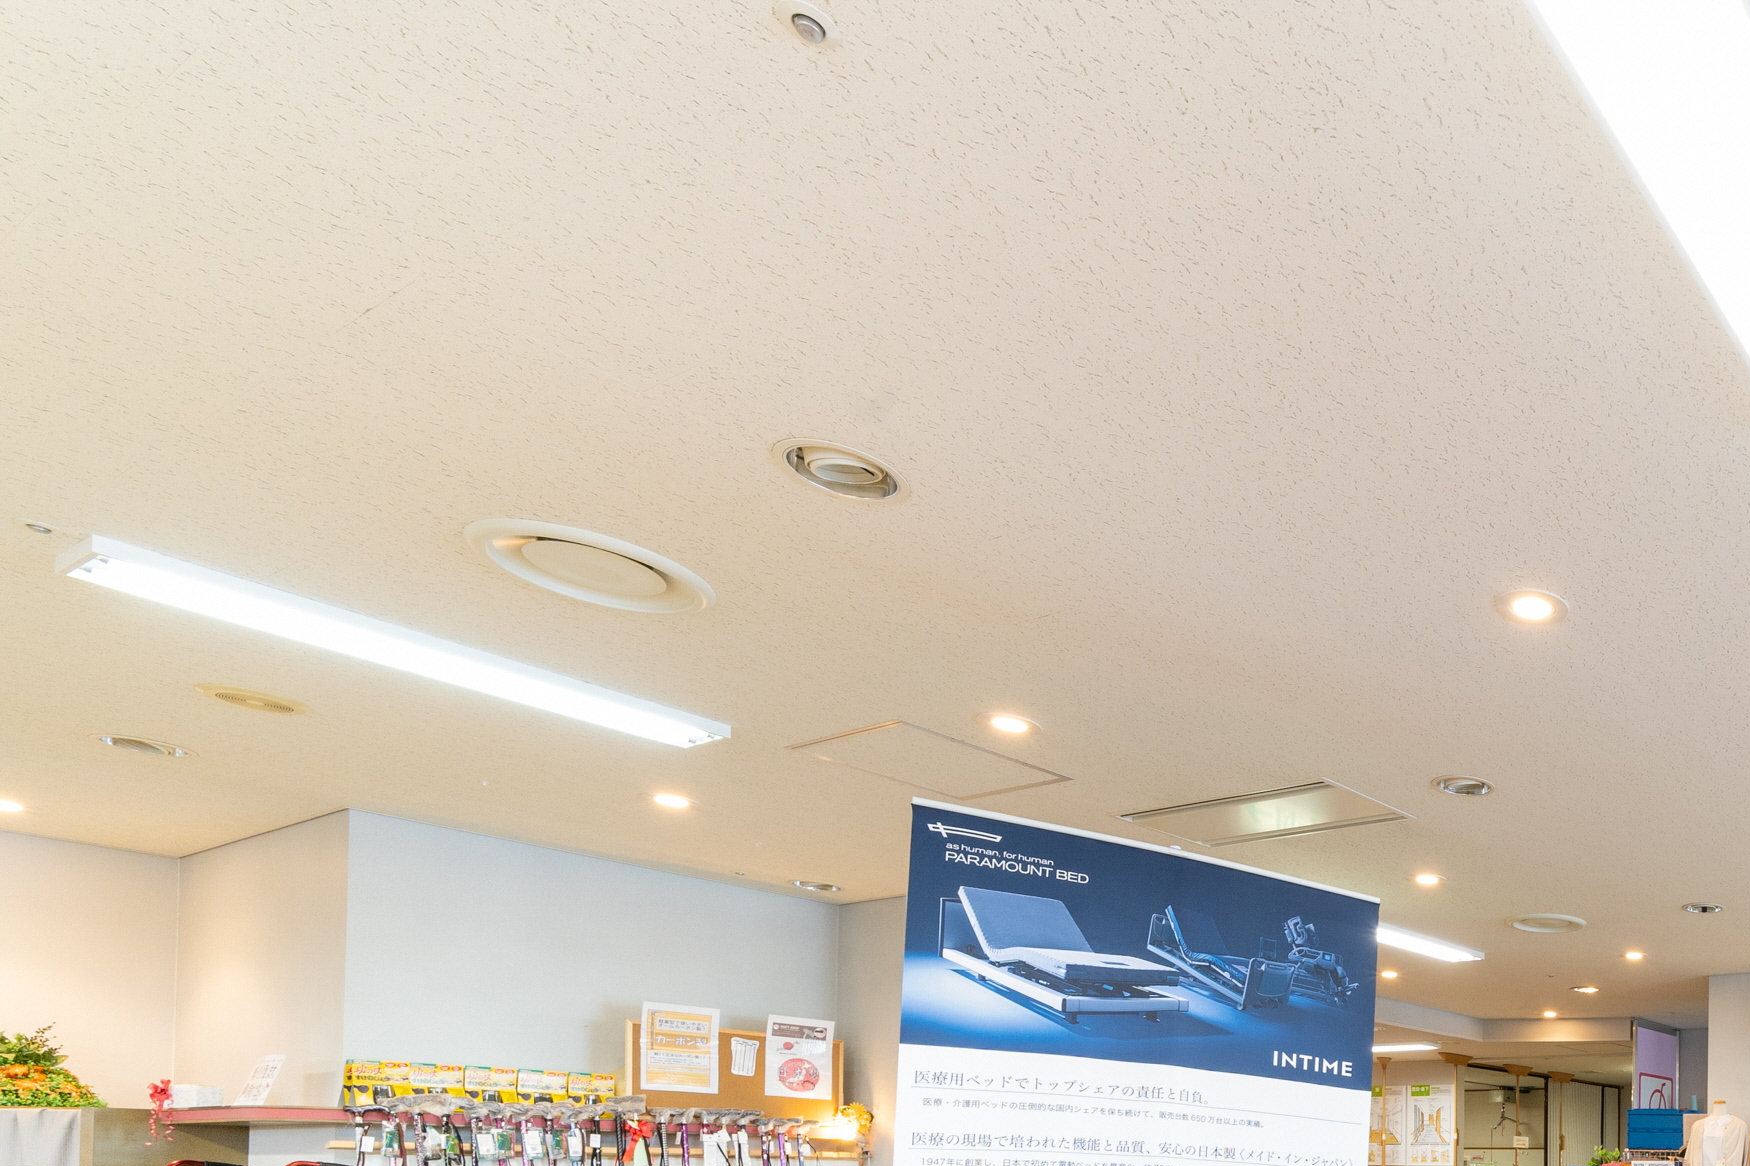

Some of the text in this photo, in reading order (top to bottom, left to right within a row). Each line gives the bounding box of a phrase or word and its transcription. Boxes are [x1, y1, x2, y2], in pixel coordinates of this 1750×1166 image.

[945, 851, 1089, 884] PARAMOUNT BED
[946, 842, 959, 850] as
[1003, 850, 1017, 860] for
[1018, 853, 1054, 866] human
[1272, 1050, 1353, 1077] INTIME
[914, 1070, 1209, 1105] 医療用ベッドでトップシェアの責任と自負。
